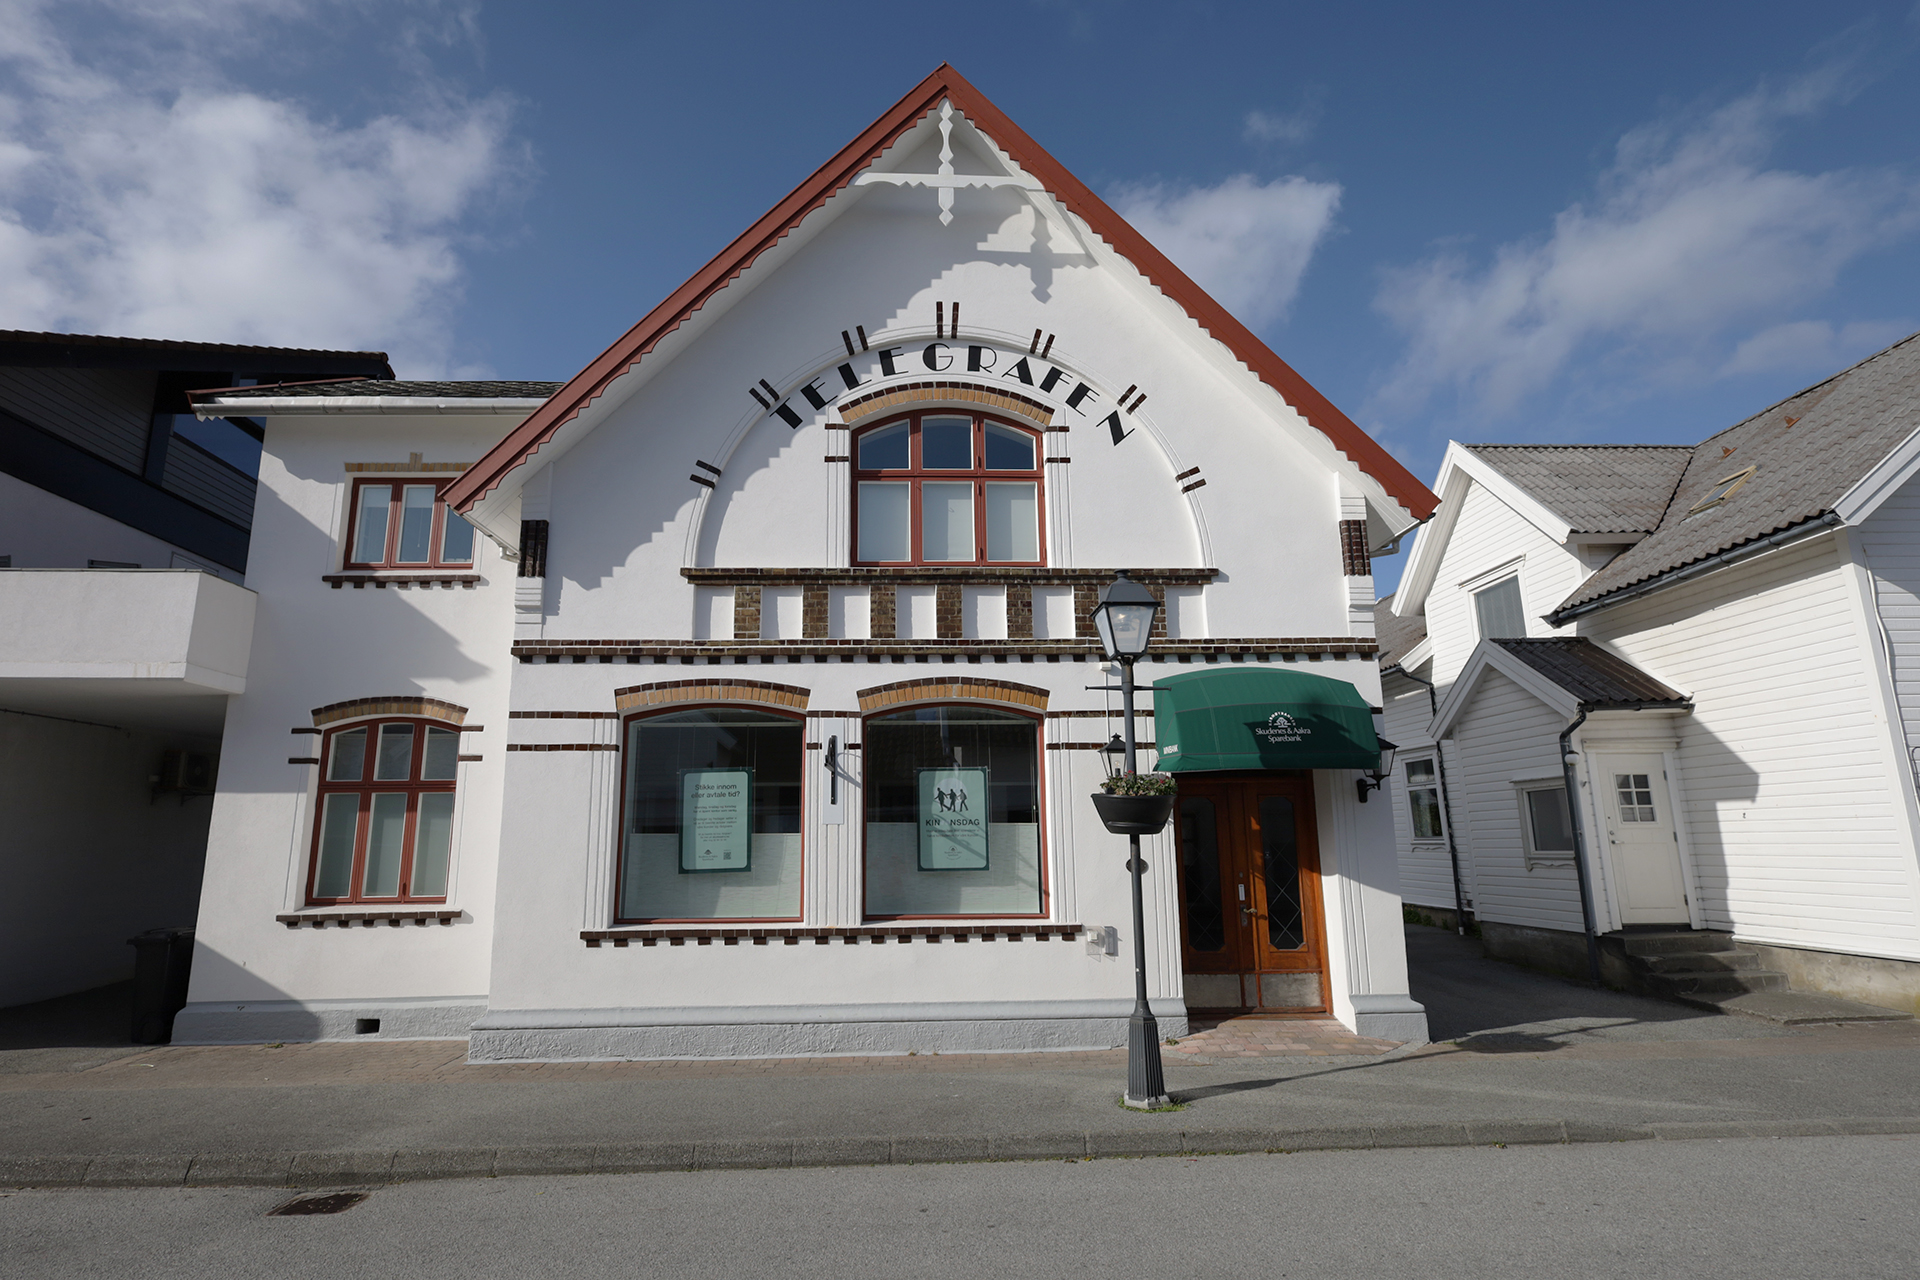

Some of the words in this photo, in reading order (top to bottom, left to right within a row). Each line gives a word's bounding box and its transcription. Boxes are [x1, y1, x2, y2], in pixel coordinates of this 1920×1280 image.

[769, 343, 1135, 447] TELEGRAFEN
[1293, 727, 1312, 735] Aakra
[1267, 735, 1302, 744] Sparebank
